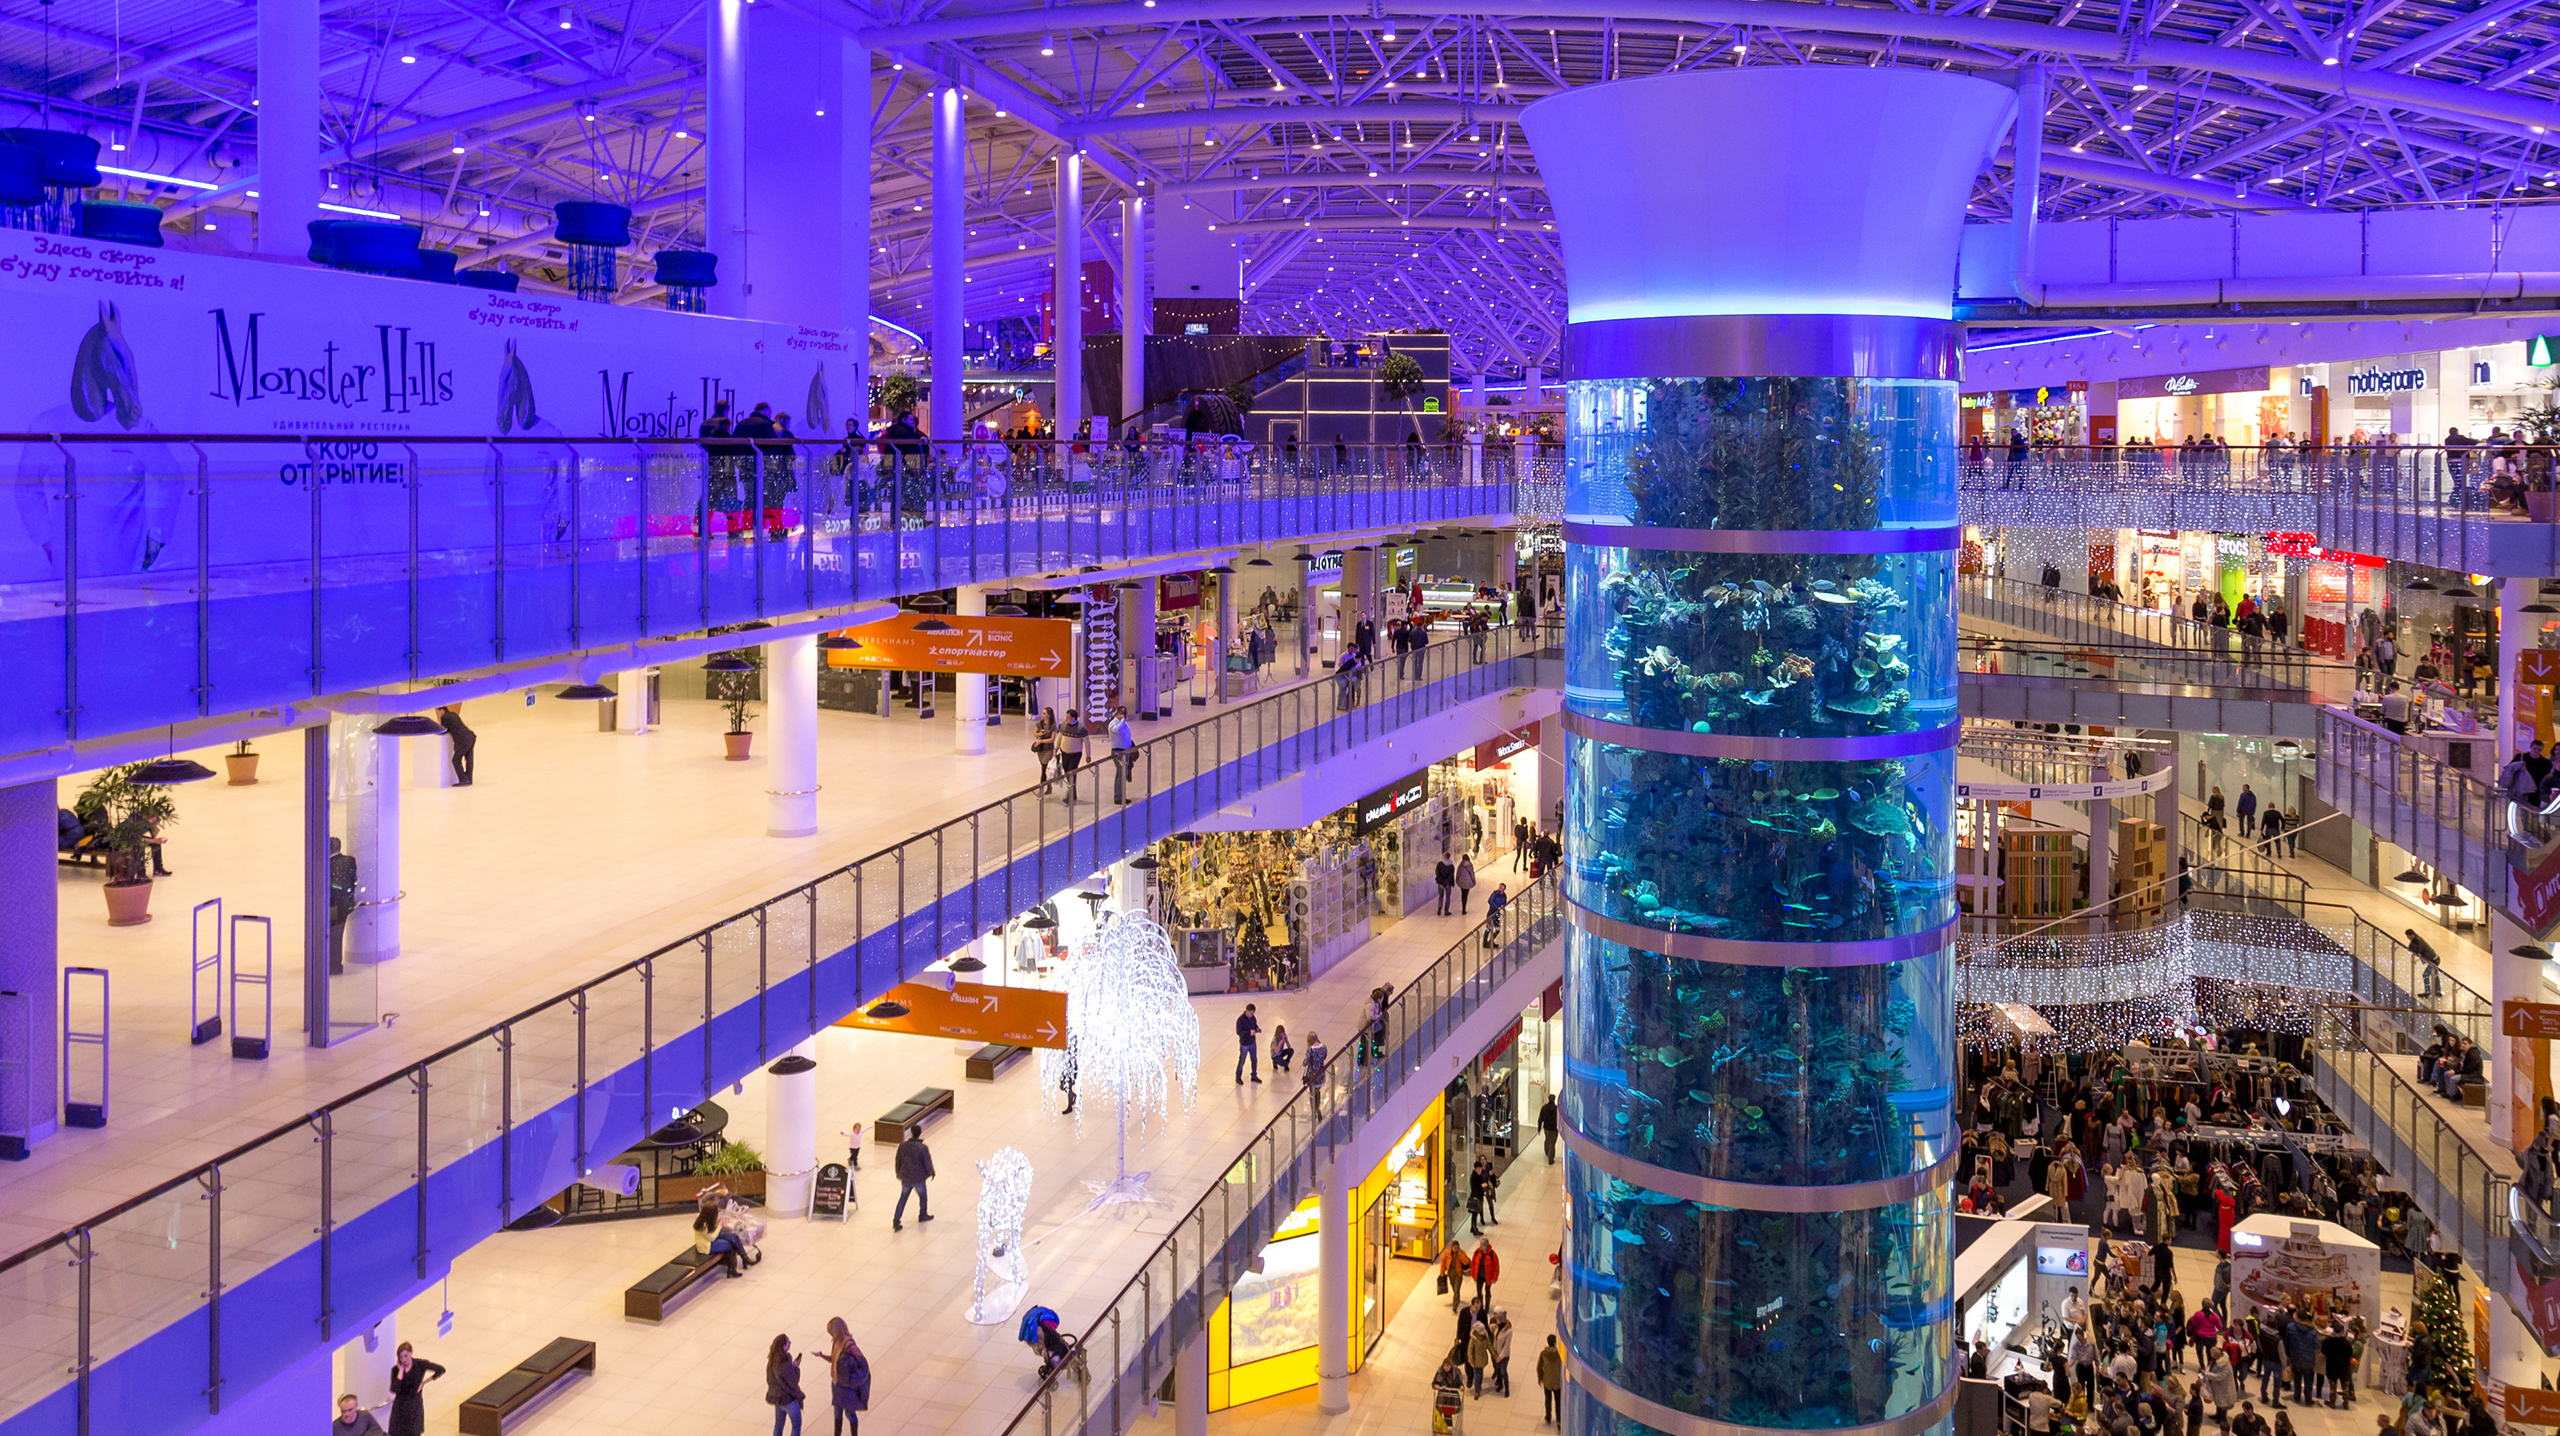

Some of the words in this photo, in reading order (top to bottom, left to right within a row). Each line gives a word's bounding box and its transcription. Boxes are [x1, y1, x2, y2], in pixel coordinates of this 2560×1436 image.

[33, 236, 92, 259] Здесь
[99, 249, 156, 269] скоро
[0, 255, 61, 282] буду
[488, 294, 524, 309] Здесь
[468, 307, 505, 327] буду
[207, 308, 376, 409] Monster
[374, 324, 454, 414] Hills
[2348, 364, 2428, 397] mothercare
[598, 369, 698, 439] Monster
[360, 423, 411, 431] РЕСТОРАН
[2217, 537, 2250, 556] crocs
[858, 636, 915, 646] DEBENHAMS
[988, 634, 1013, 642] BIONIC
[939, 646, 1006, 659] спортмастер
[1087, 595, 1118, 724] Affliction
